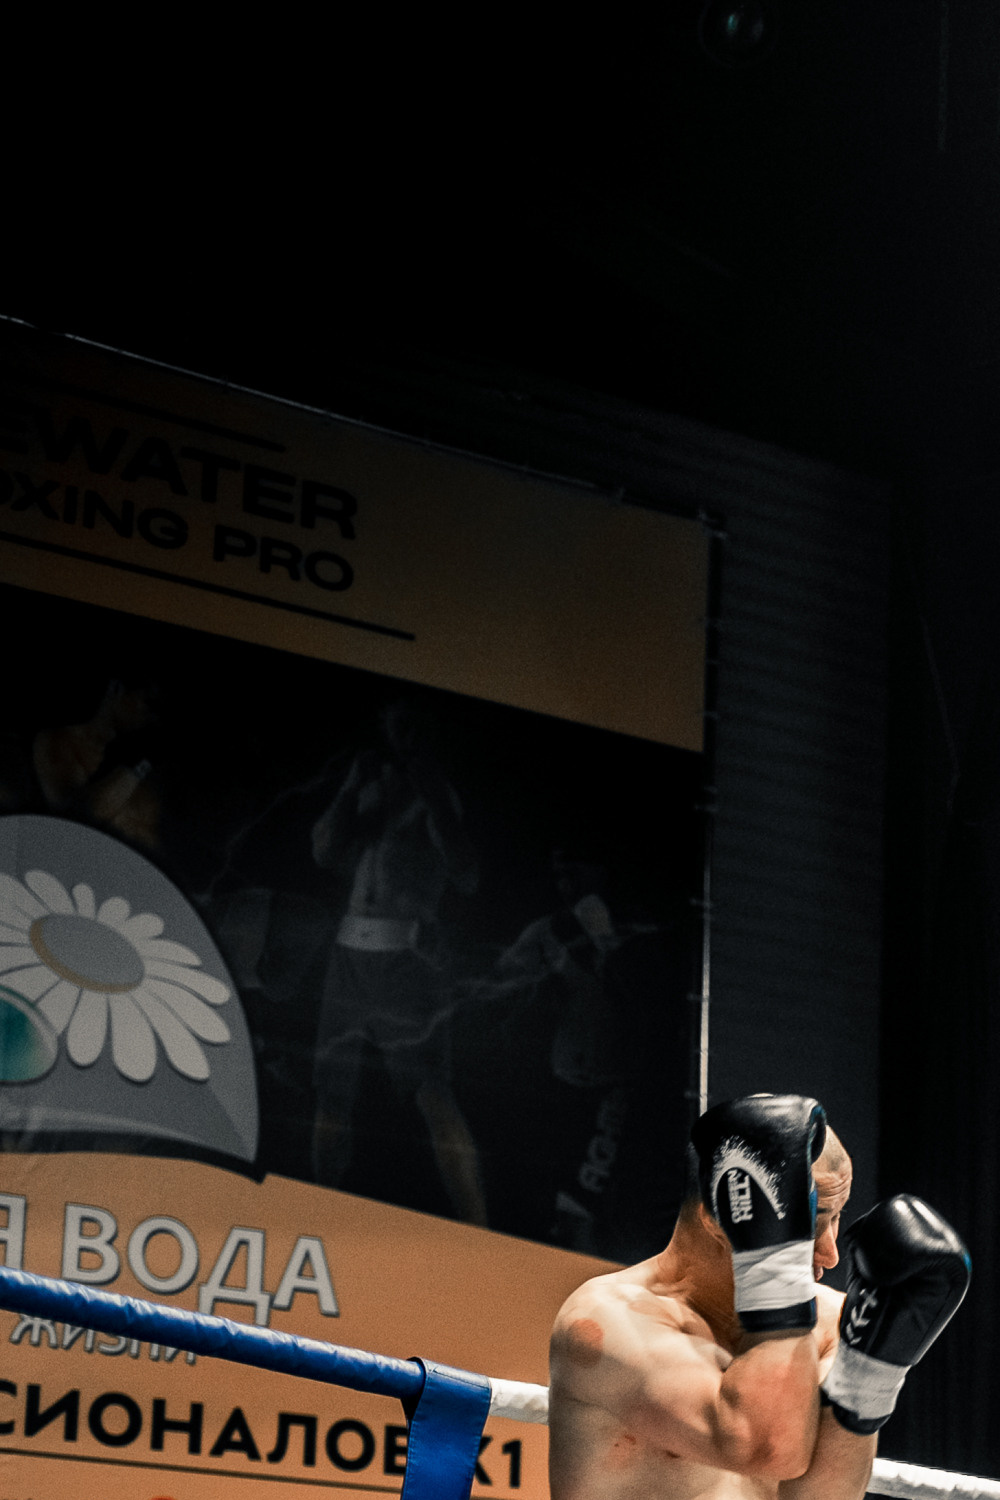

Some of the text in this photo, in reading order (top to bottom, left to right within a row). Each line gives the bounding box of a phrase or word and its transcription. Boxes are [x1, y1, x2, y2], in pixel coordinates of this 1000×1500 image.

[0, 467, 354, 591] XING PRO
[60, 1201, 341, 1326] ВОДА
